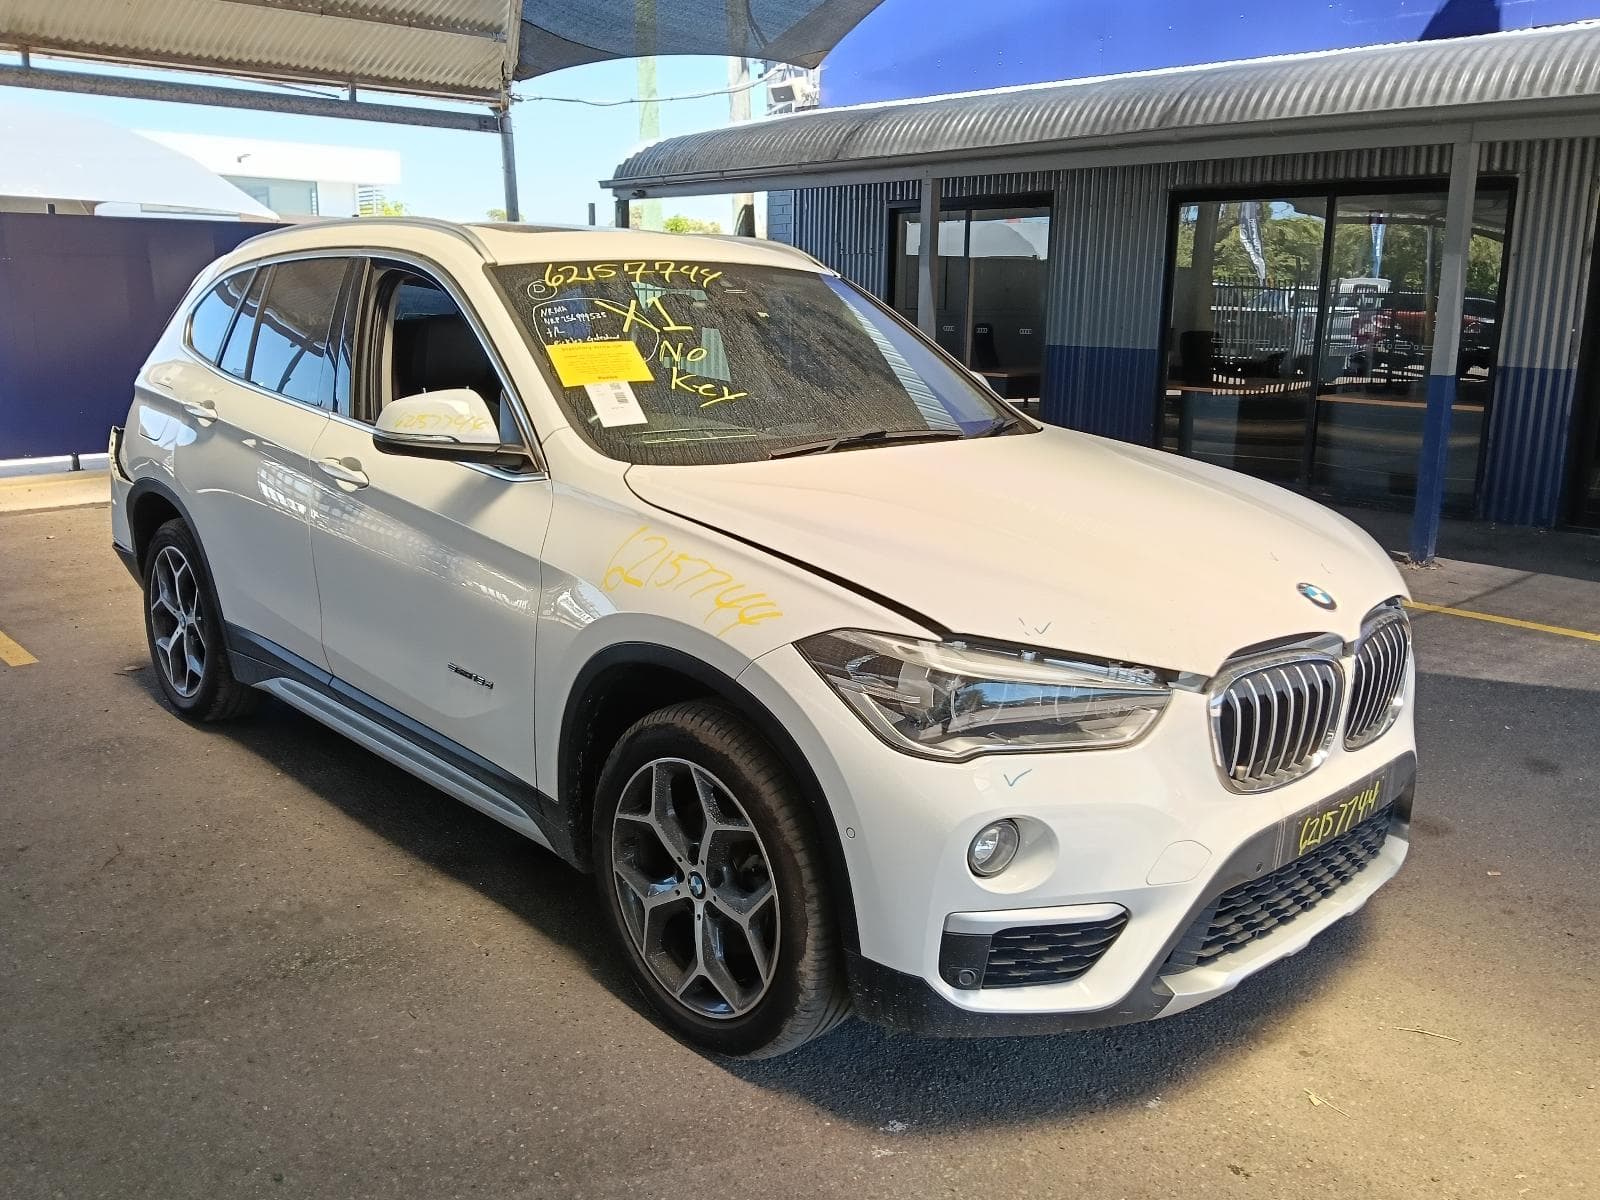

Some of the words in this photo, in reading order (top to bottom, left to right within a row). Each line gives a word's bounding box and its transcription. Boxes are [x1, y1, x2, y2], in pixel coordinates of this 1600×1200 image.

[544, 262, 722, 288] 62157744
[594, 297, 694, 333] X1
[659, 340, 708, 364] No
[670, 366, 748, 408] Key
[1298, 780, 1380, 856] 62157744
